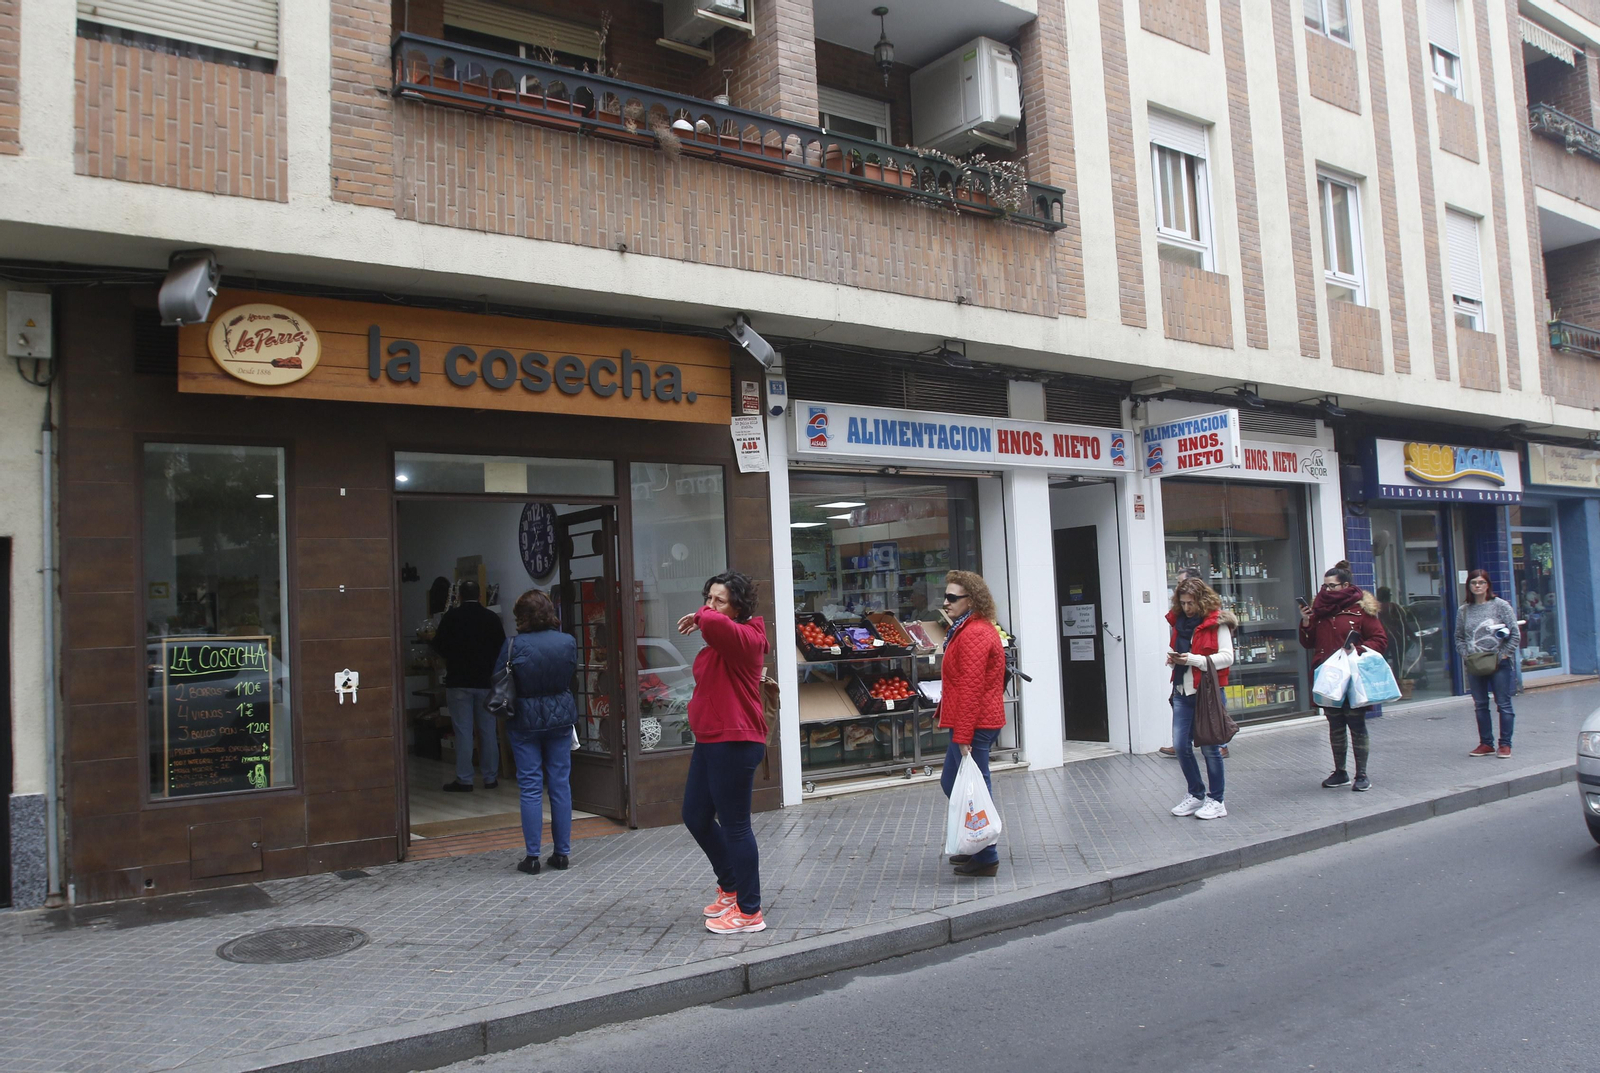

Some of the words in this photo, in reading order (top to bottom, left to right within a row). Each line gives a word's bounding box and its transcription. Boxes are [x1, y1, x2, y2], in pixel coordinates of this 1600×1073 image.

[233, 330, 255, 355] La
[254, 328, 308, 354] Parra
[368, 324, 421, 383] la
[445, 345, 698, 403] cosecha.
[847, 416, 992, 452] ALIMENTACION
[997, 429, 1048, 457] HNOS.
[1053, 433, 1101, 460] NIETO
[1144, 414, 1228, 443] ALIMENTACION
[742, 442, 758, 450] ABB
[1178, 432, 1224, 453] HNOS.
[1177, 448, 1224, 470] NIETO
[1244, 448, 1270, 471] HNOS.
[1273, 450, 1298, 474] NIETO
[1404, 442, 1454, 474] SECO
[1455, 447, 1504, 476] AGUA
[1382, 487, 1463, 500] TINTORERIA
[1478, 492, 1521, 502] RAPIDA
[531, 503, 540, 522] 12
[546, 514, 551, 524] 2
[522, 532, 528, 550] 9
[547, 525, 554, 544] 3
[524, 551, 529, 561] 8
[536, 554, 543, 572] 6
[170, 646, 198, 674] LA
[175, 683, 188, 702] 2
[178, 705, 189, 722] 4
[178, 726, 190, 741] 3
